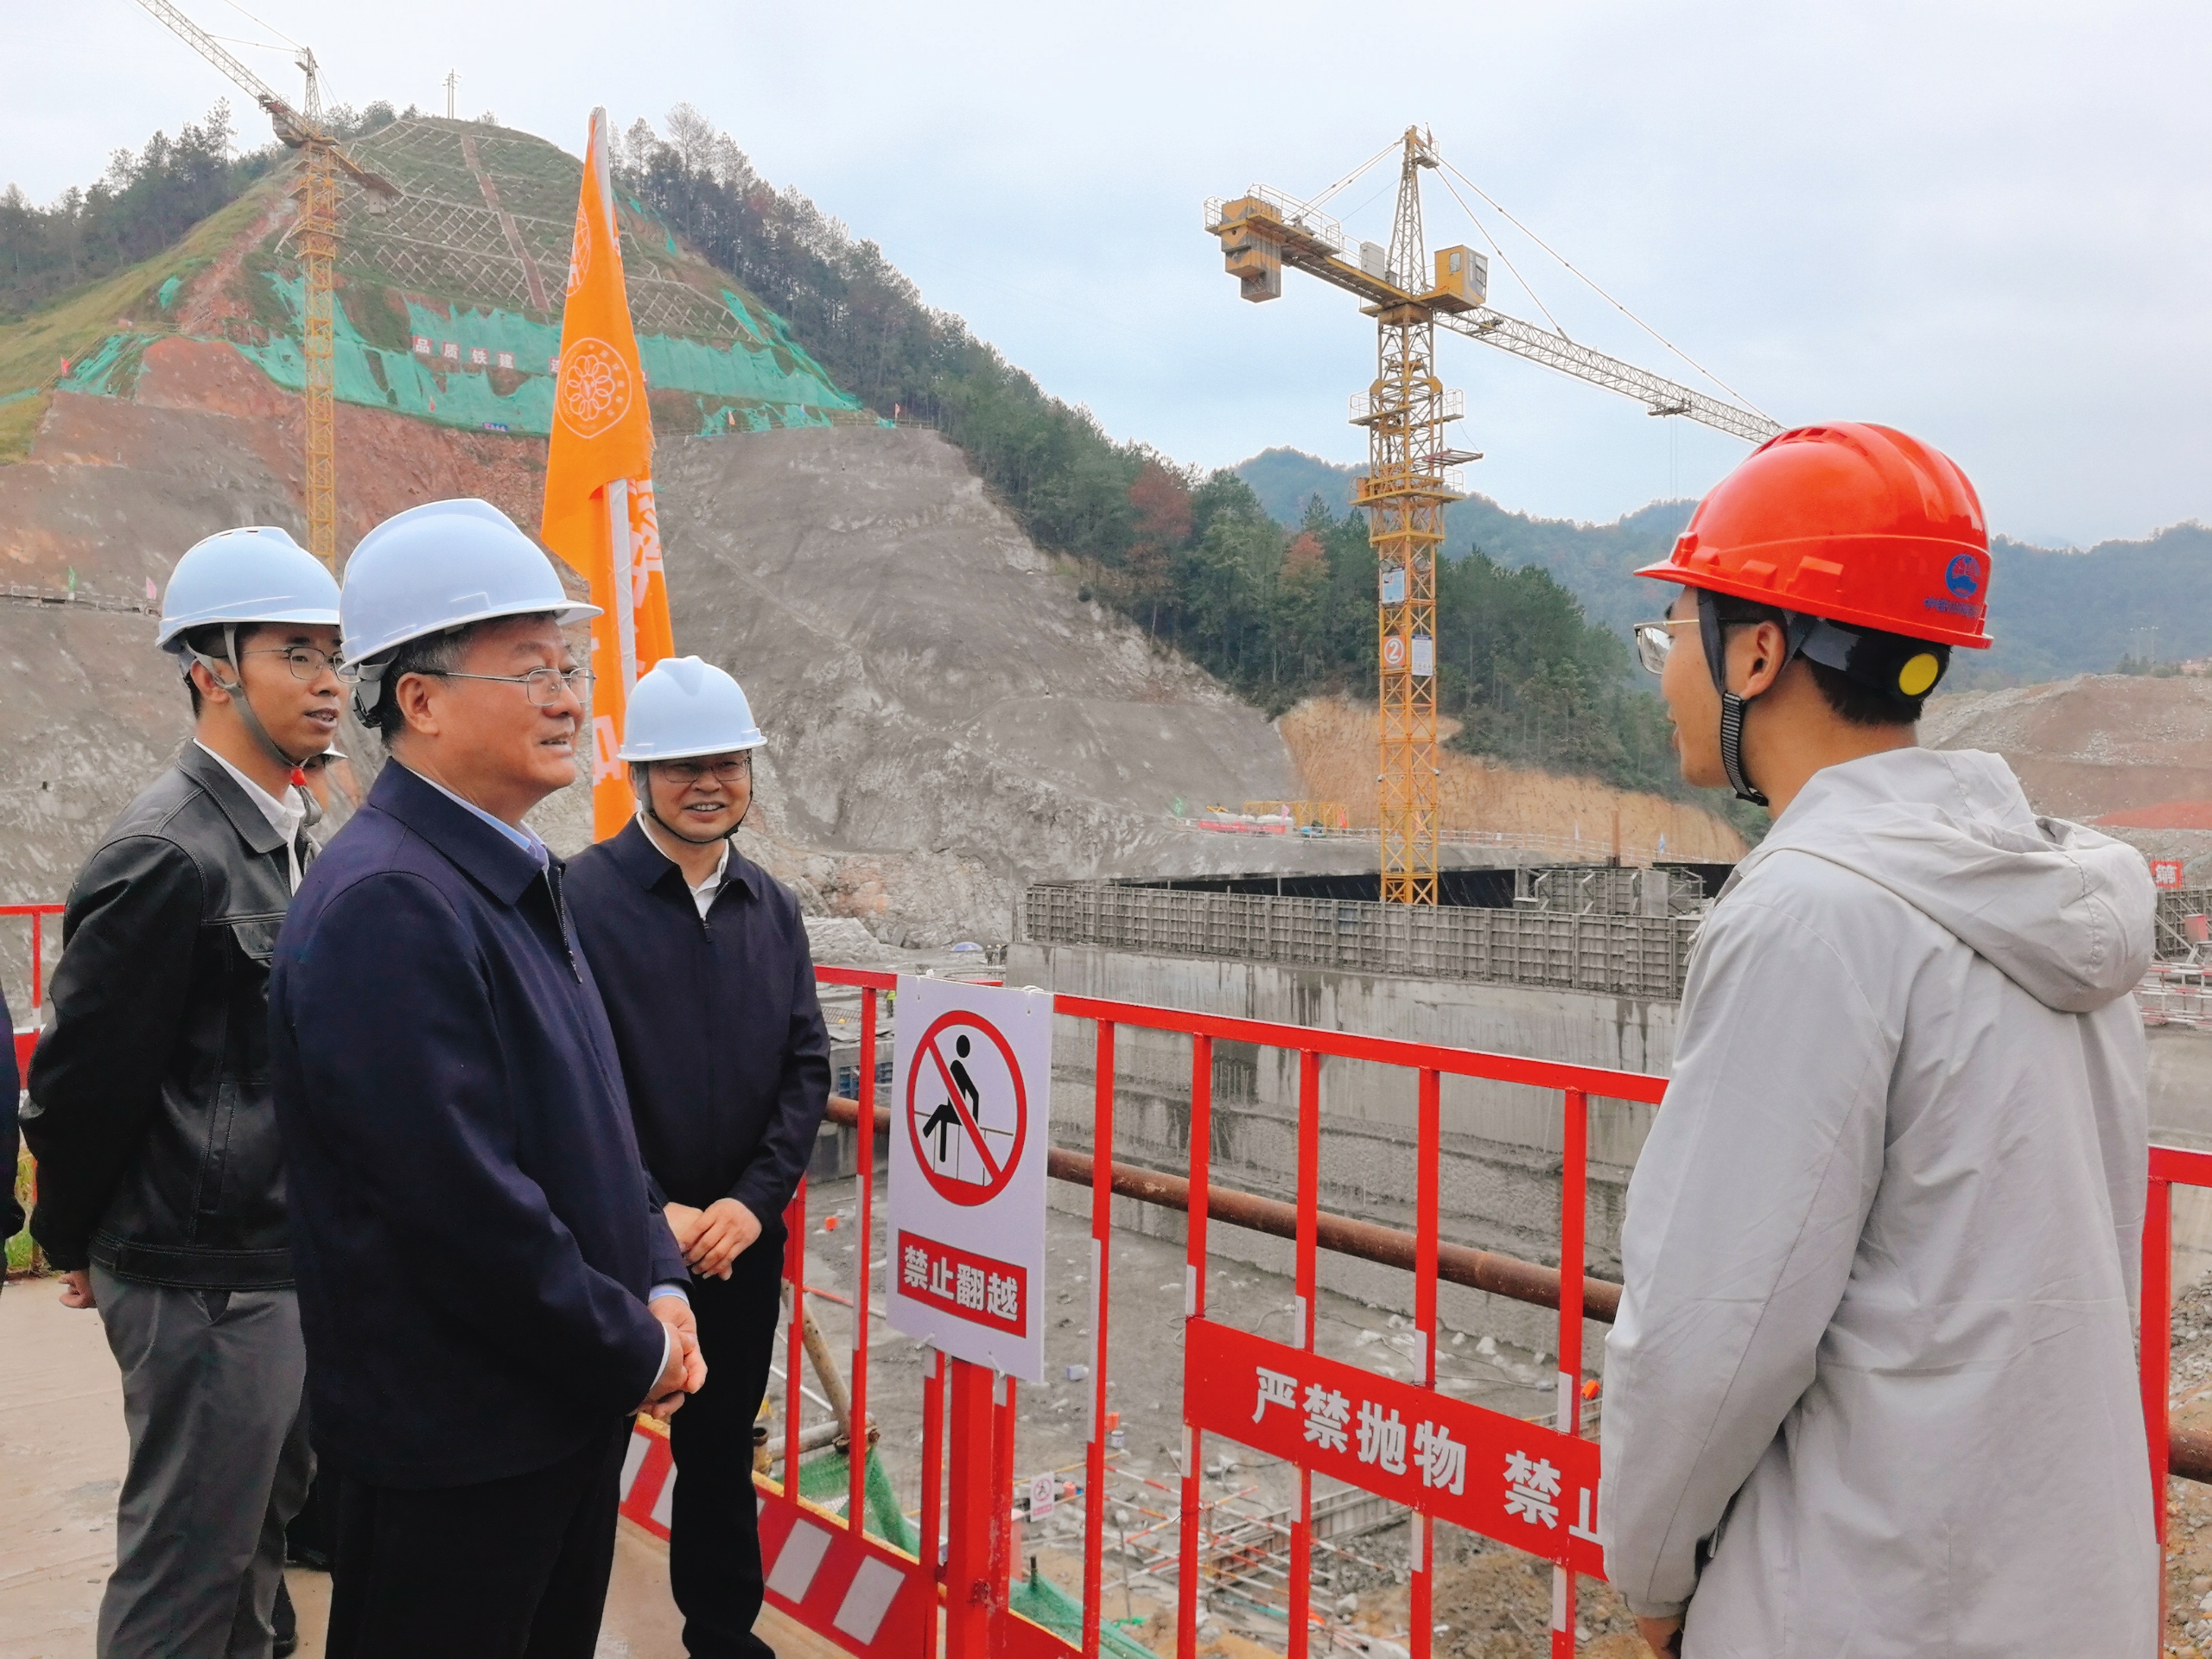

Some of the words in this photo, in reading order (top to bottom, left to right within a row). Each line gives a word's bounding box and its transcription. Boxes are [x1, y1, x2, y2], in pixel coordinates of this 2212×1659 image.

[416, 338, 514, 369] 品质铁建
[1389, 641, 1400, 660] 2
[904, 1245, 1018, 1322] 禁止翻越
[1252, 1365, 1467, 1497] 严禁抛物
